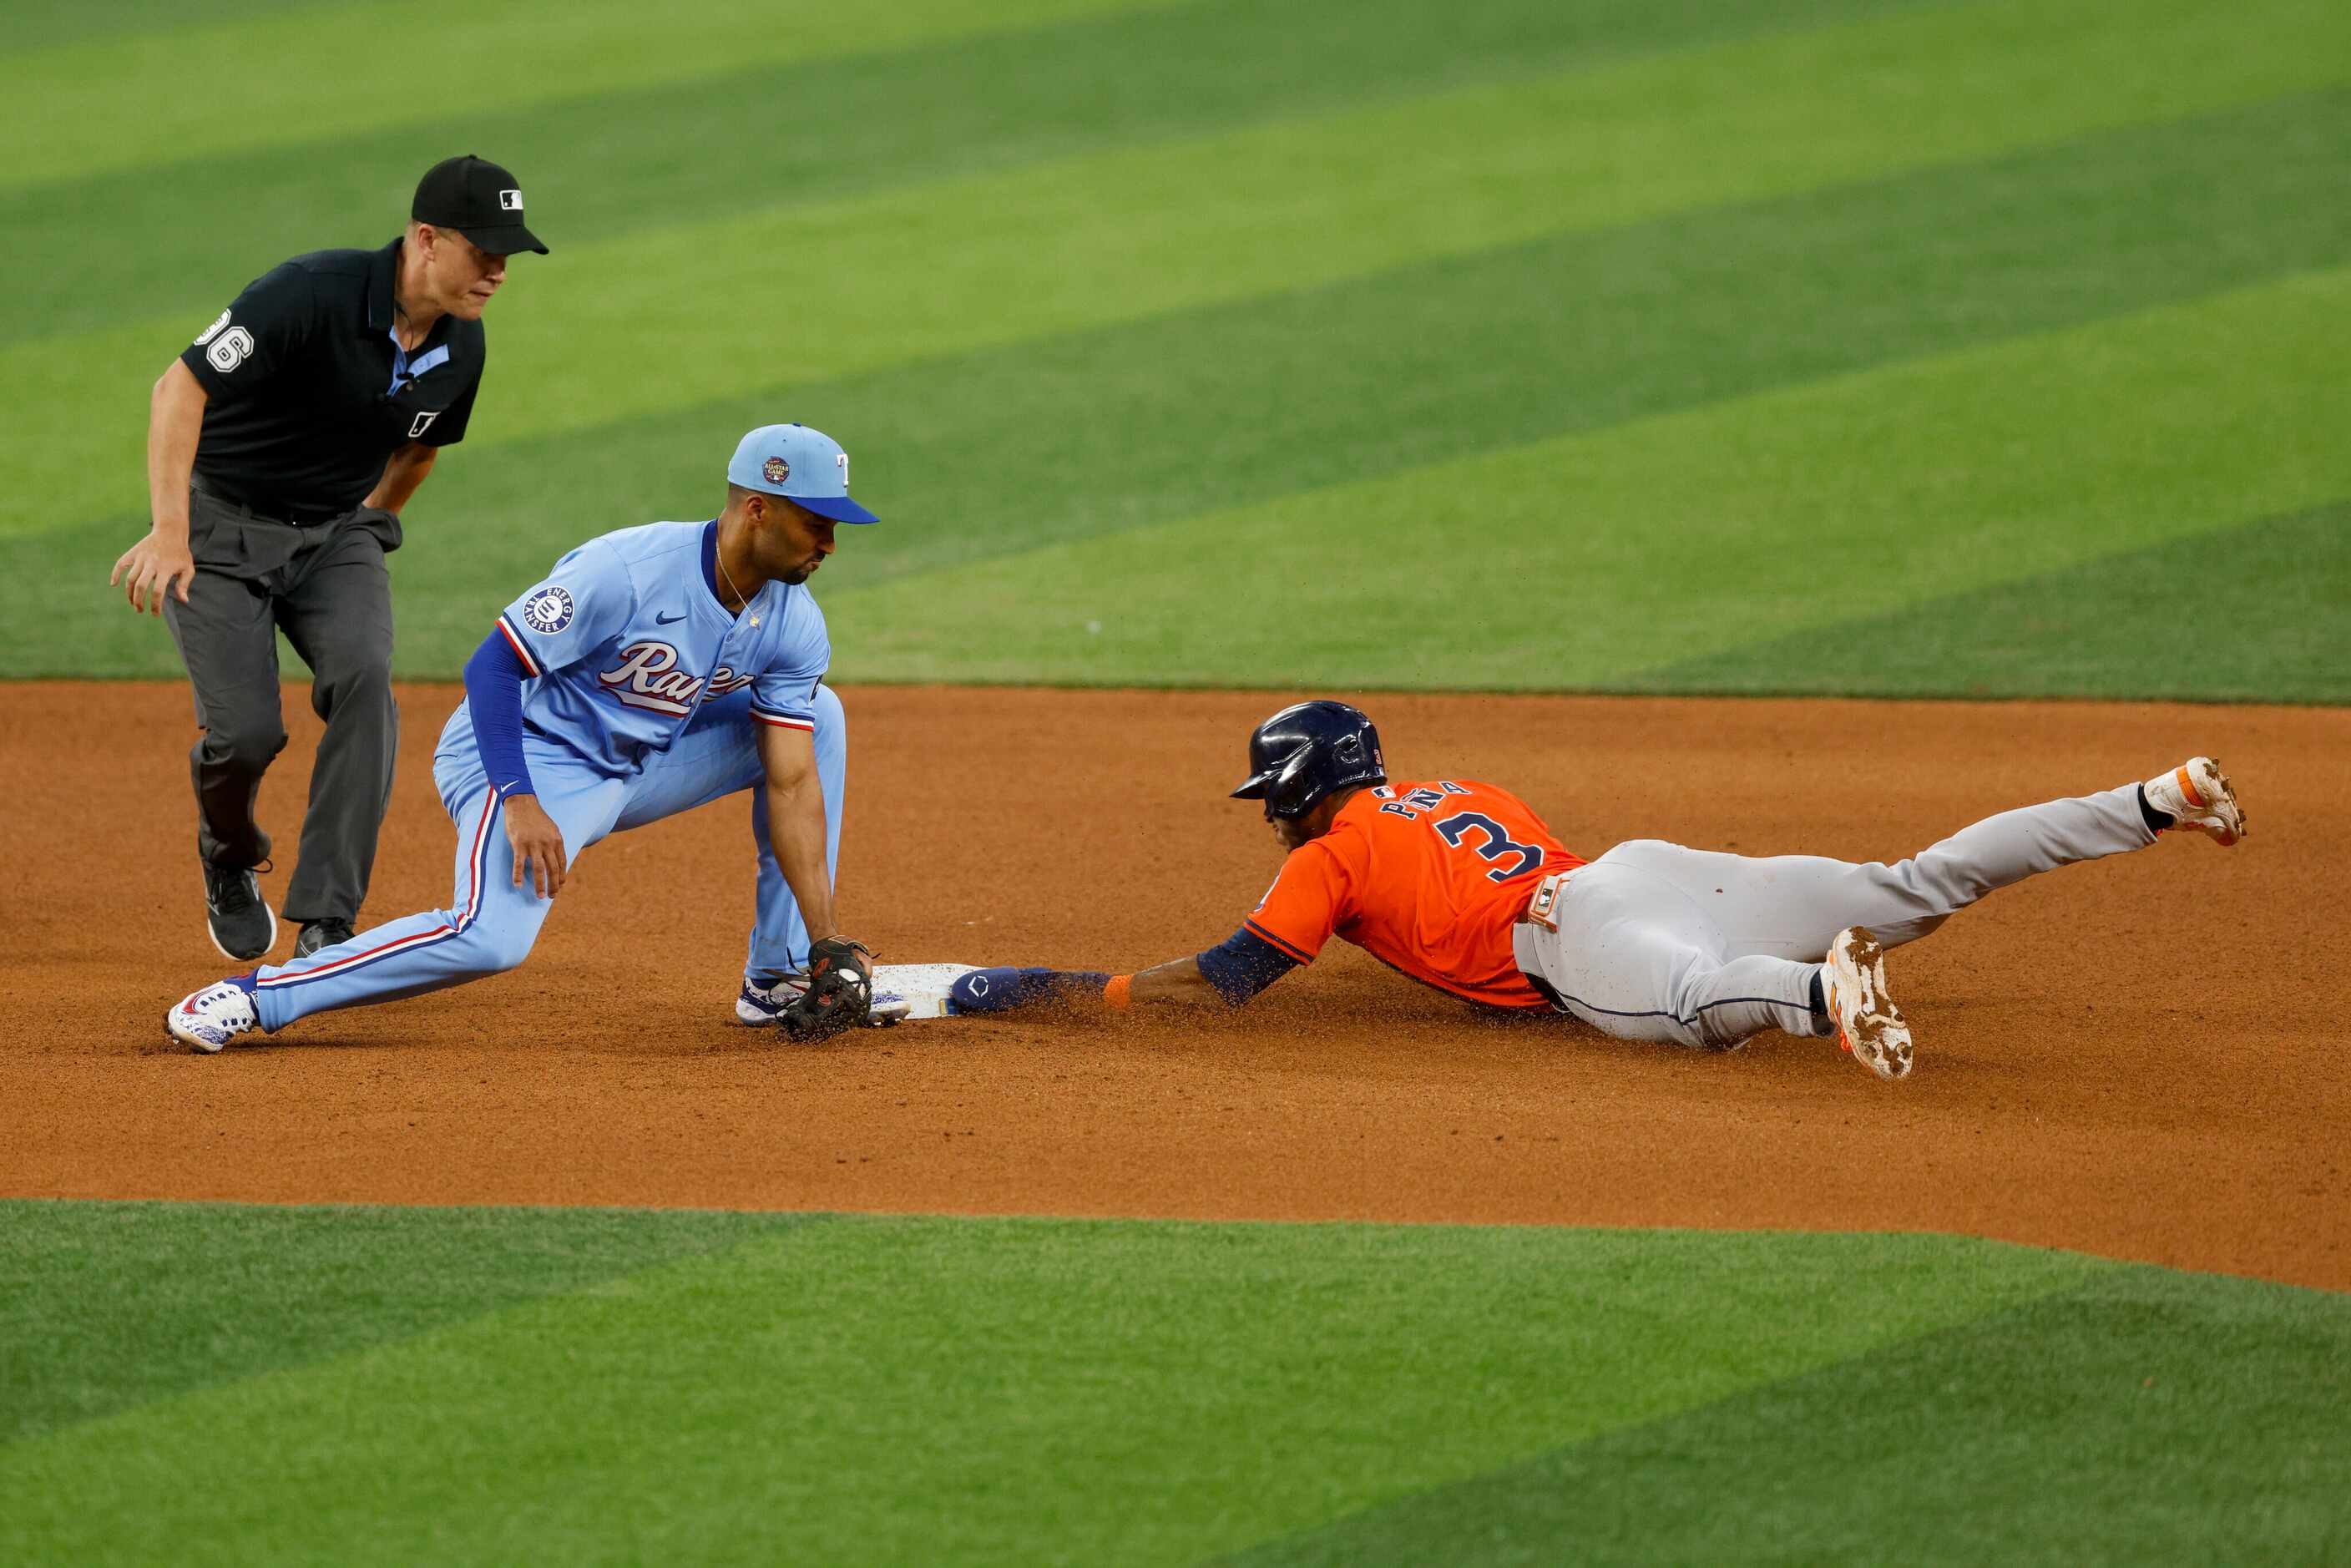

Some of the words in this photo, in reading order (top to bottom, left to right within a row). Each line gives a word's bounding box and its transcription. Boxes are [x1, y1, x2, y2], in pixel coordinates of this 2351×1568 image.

[524, 595, 560, 632] TRANSFER
[547, 588, 573, 623] ENERGY
[1432, 811, 1545, 883] 3
